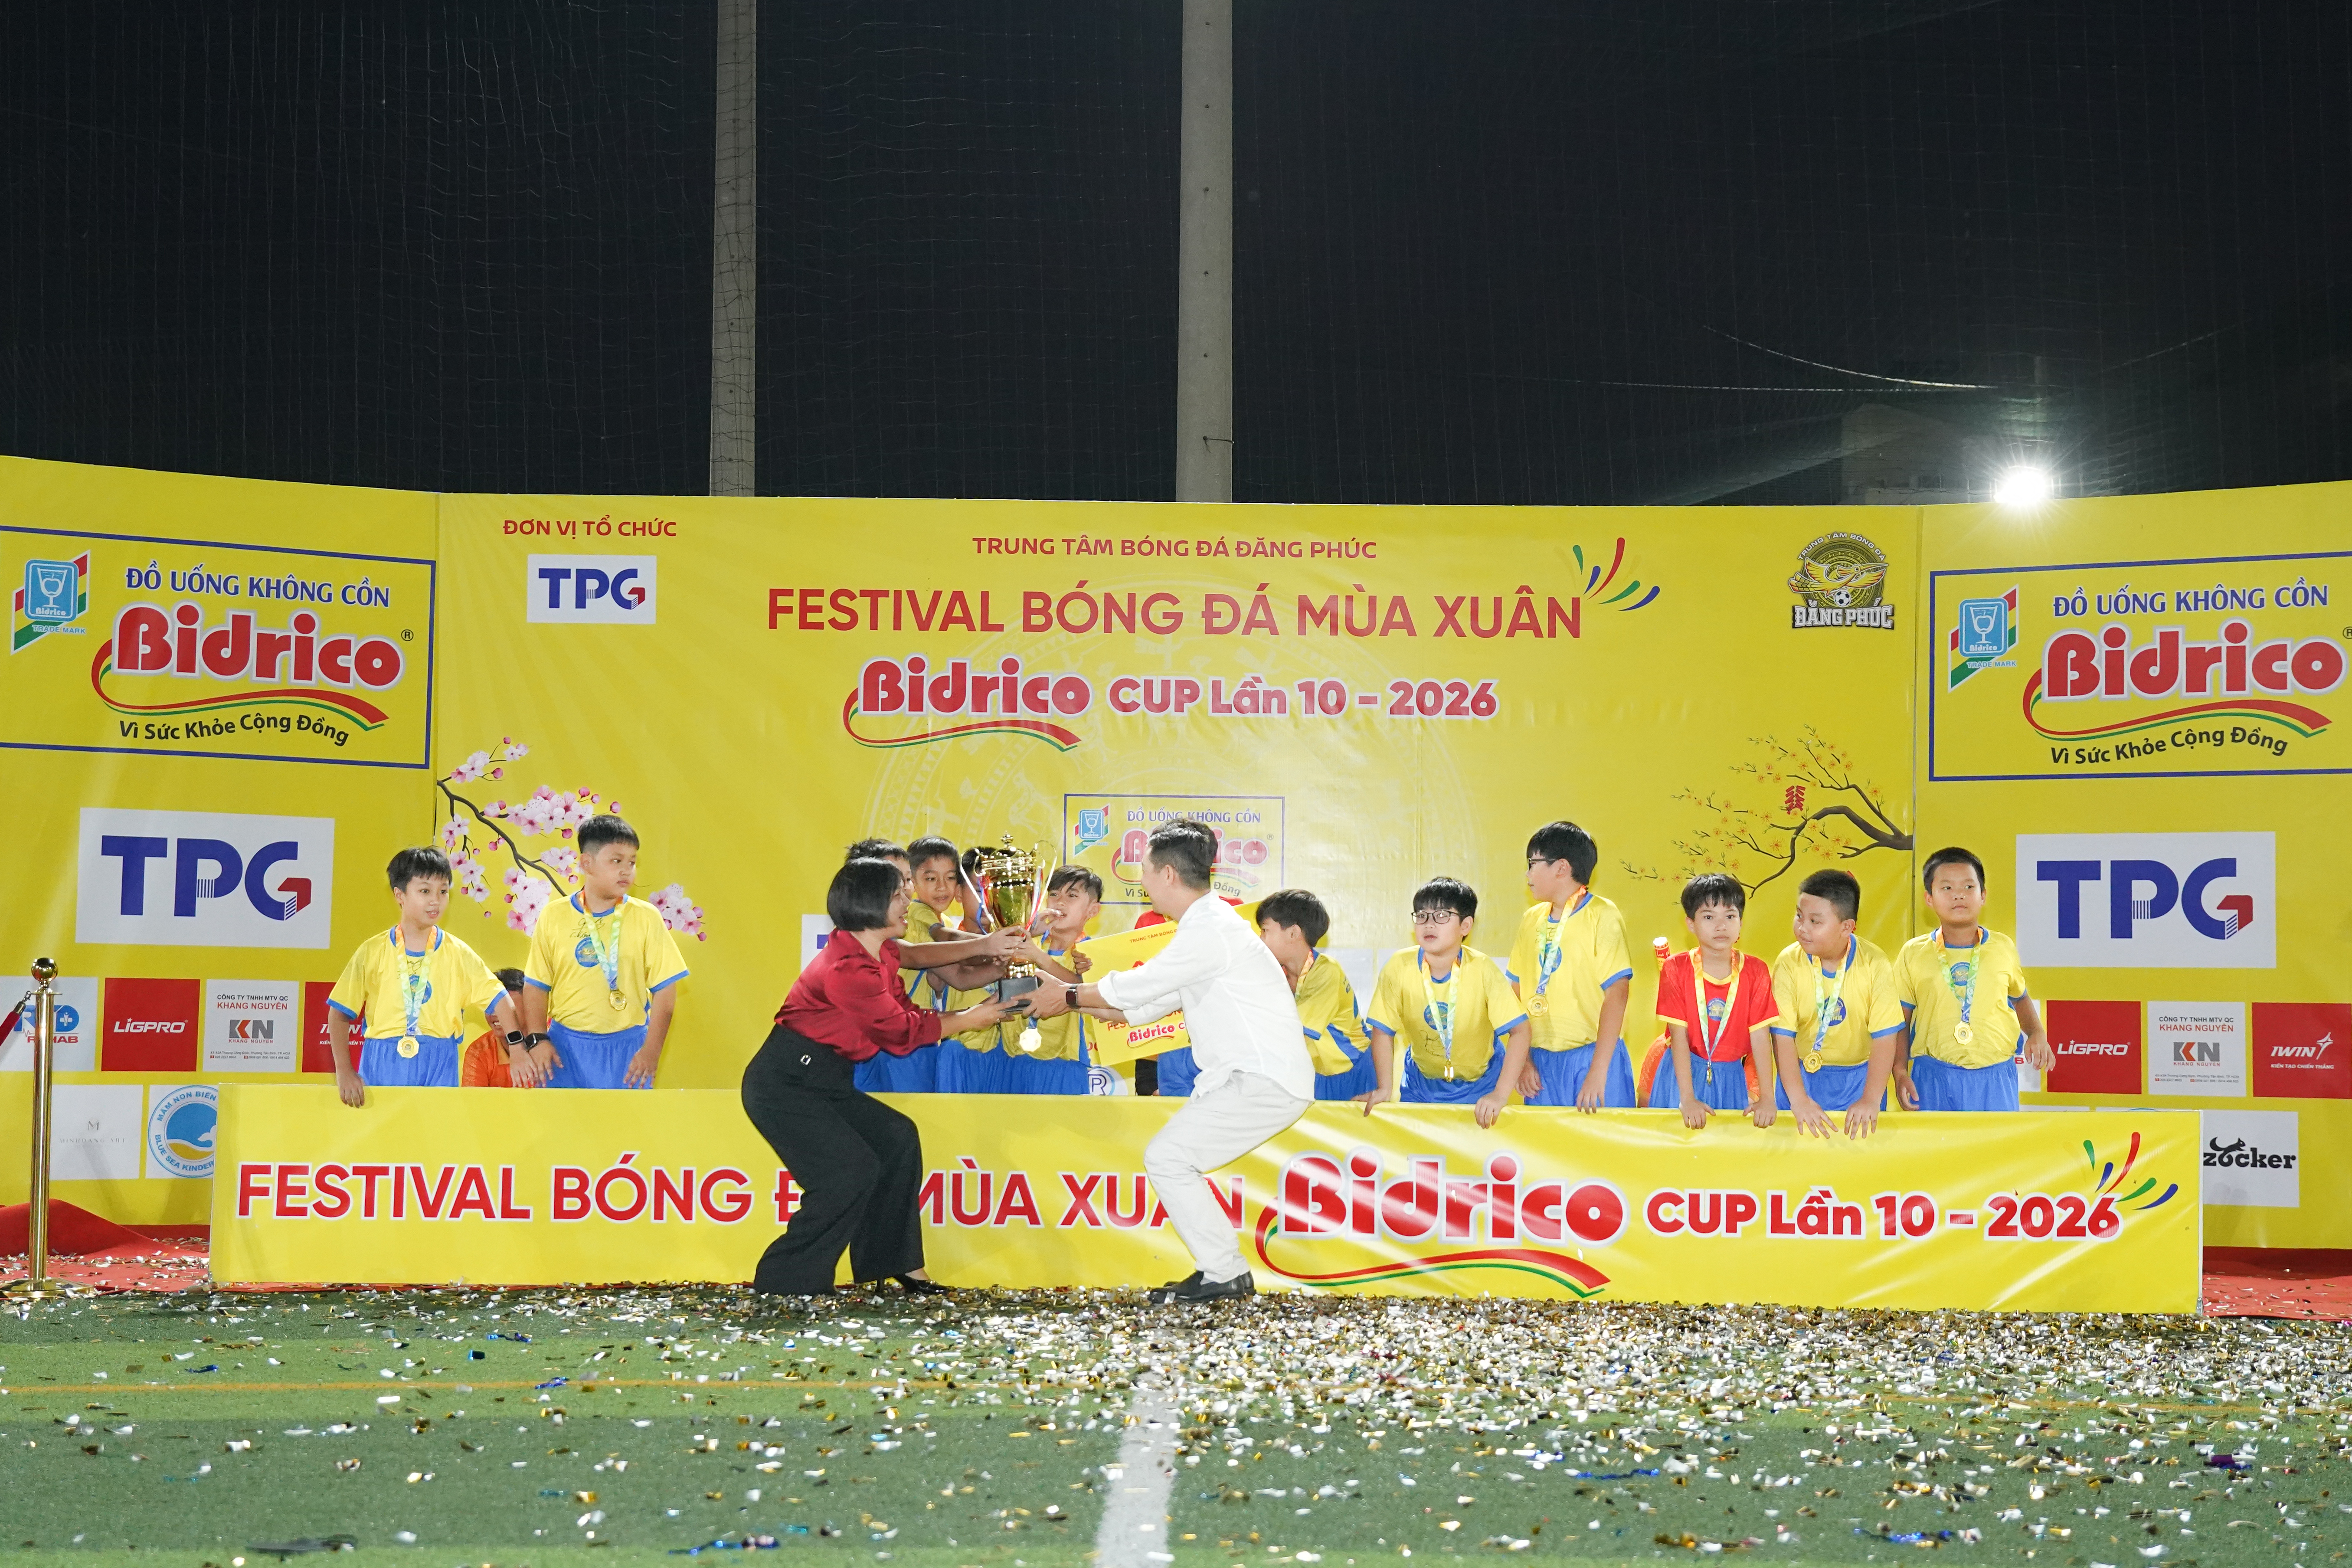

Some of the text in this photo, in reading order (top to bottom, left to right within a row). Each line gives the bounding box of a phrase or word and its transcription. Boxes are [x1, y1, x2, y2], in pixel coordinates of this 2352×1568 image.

[503, 514, 677, 539] ĐƠN VỊ TỔ CHỨC
[972, 534, 1377, 559] TRUNG TÂM BÓNG ĐÁ ĐĂNG PHÚC
[1798, 537, 1824, 560] TRUNG
[1850, 534, 1875, 549] BÓNG
[1874, 548, 1887, 561] ĐÁ
[125, 560, 389, 607] ĐỒ UỐNG KHÔNG CỒN
[538, 568, 645, 610] TPG
[2053, 577, 2329, 618] ĐỒ UỐNG KHÔNG CỒN
[35, 607, 66, 616] Bidrico
[769, 580, 1581, 639] FESTIVAL BÓNG ĐÁ MÙA XUÂN
[1793, 597, 1894, 629] ĐĂNG PHÚC
[115, 604, 402, 687] Bidrico
[2046, 622, 2344, 698] Bidrico
[861, 656, 1091, 717] Bidrico
[1109, 678, 1200, 714] CUP
[1211, 675, 1287, 715] Lần
[1299, 680, 1347, 716] 10
[1388, 680, 1498, 717] 2026
[119, 713, 350, 747] Vì Sức Khỏe Cộng Đồng
[2051, 727, 2288, 765] Vì Sức Khỏe Cộng Đồng
[1127, 806, 1261, 823] ĐỒ UỐNG KHÔNG CỒN
[101, 835, 312, 922] TPG
[1213, 881, 1241, 897] Đồng
[2036, 858, 2253, 940] TPG
[251, 1001, 288, 1010] NGUYÊN
[229, 1019, 274, 1039] KN
[1129, 1024, 1175, 1042] Bidrico
[2195, 1023, 2234, 1032] NGUYÊN
[2173, 1041, 2220, 1062] KN
[2270, 1046, 2316, 1057] IWIN
[172, 1091, 193, 1103] NON
[155, 1134, 168, 1156] BLUE
[165, 1155, 180, 1169] SEA
[237, 1163, 532, 1220] FESTIVAL
[552, 1152, 754, 1224] BÓNG
[1059, 1173, 1243, 1229] XUN
[1283, 1150, 1626, 1243] Bidrico
[1645, 1190, 1759, 1236] CUP
[1769, 1187, 1862, 1236] Lần
[1873, 1194, 1937, 1238] 10
[1986, 1194, 2122, 1240] 2026
